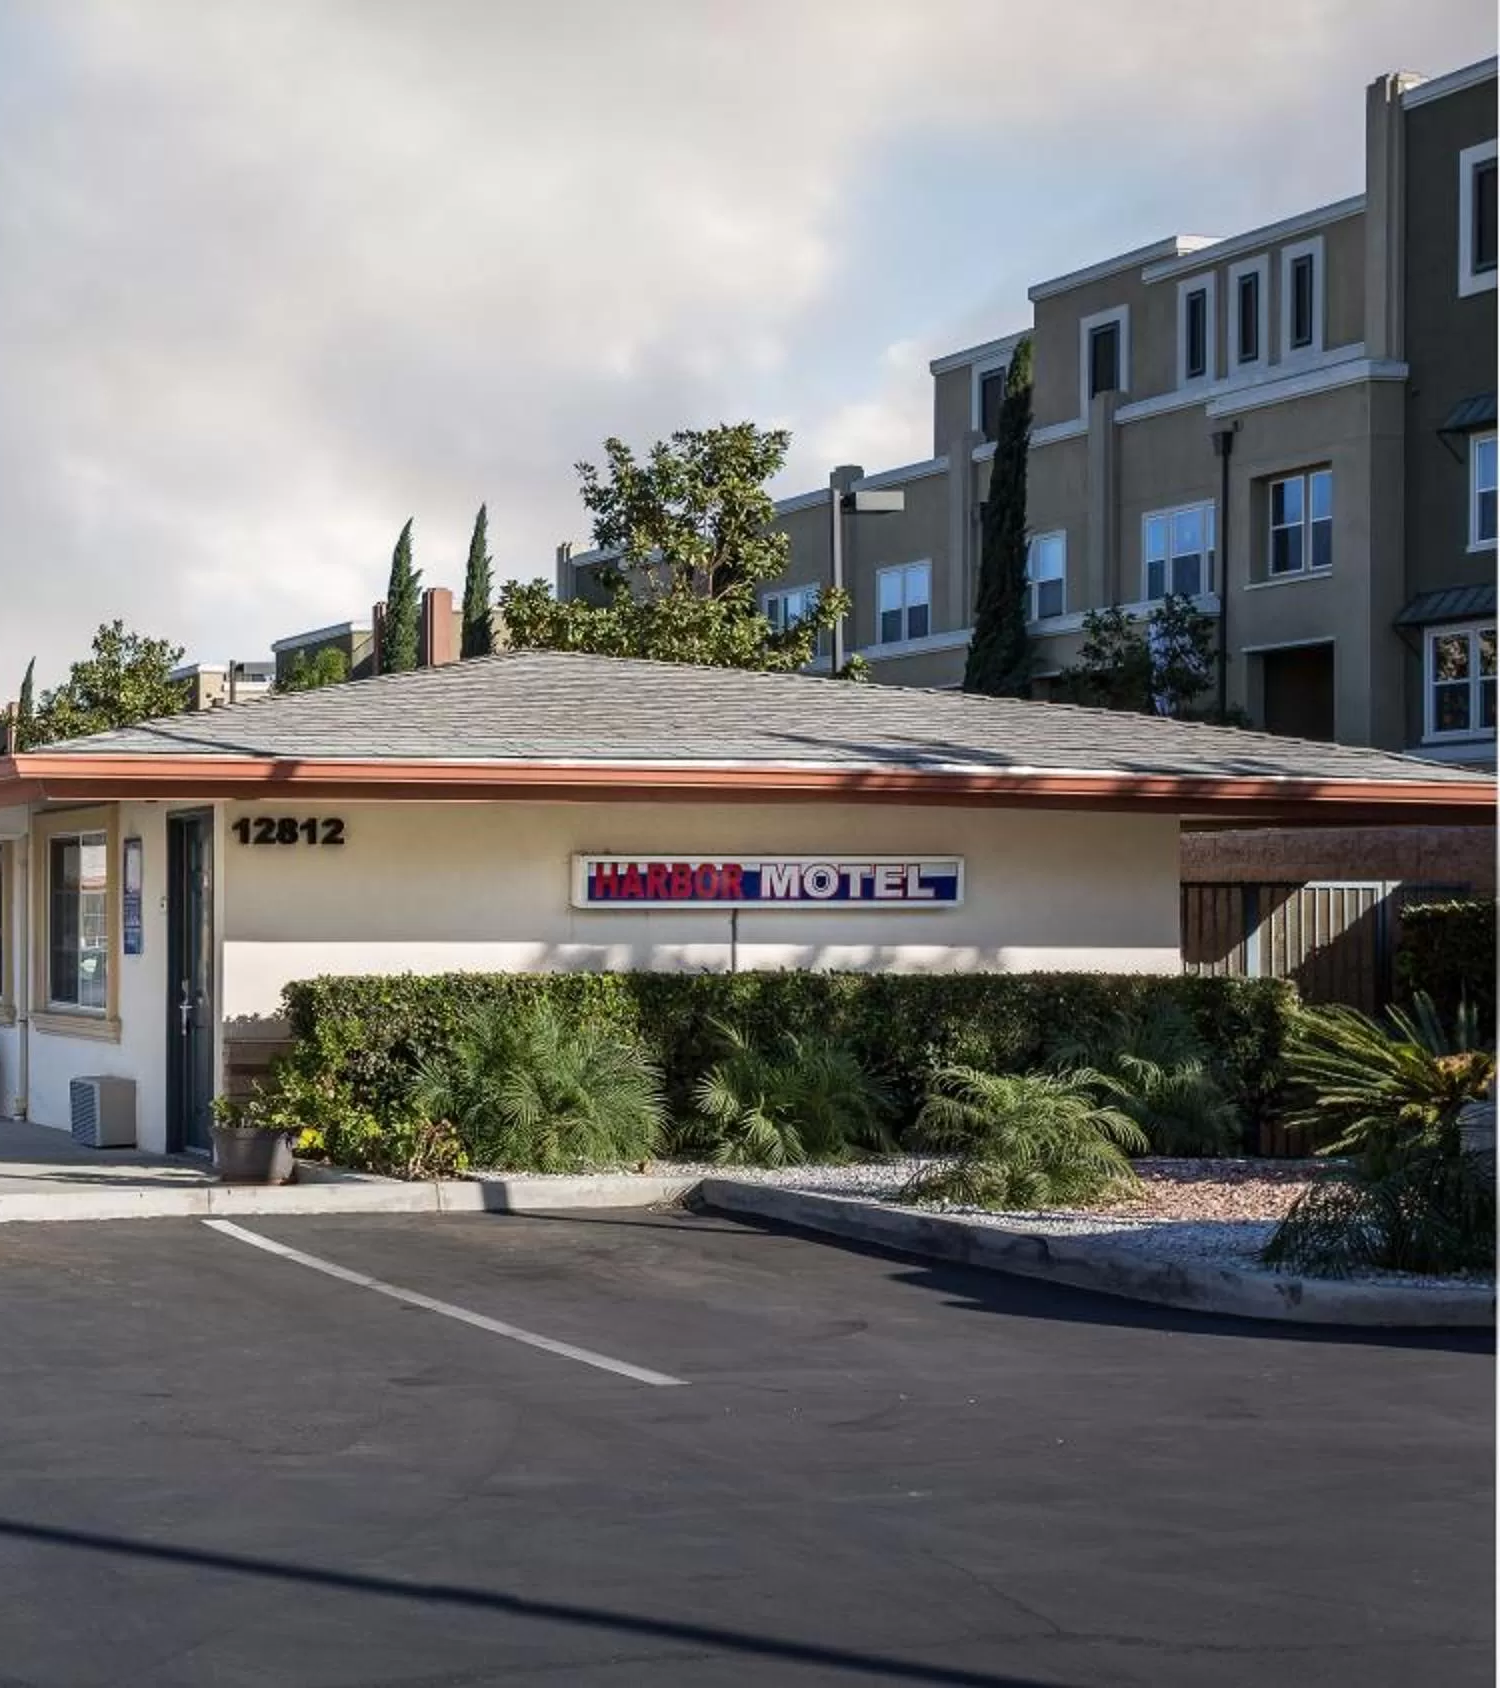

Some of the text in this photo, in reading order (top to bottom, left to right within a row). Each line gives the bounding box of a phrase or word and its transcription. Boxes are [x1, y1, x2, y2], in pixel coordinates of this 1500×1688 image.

[231, 817, 345, 844] 12812
[595, 862, 936, 898] HARBOR MOTEL
